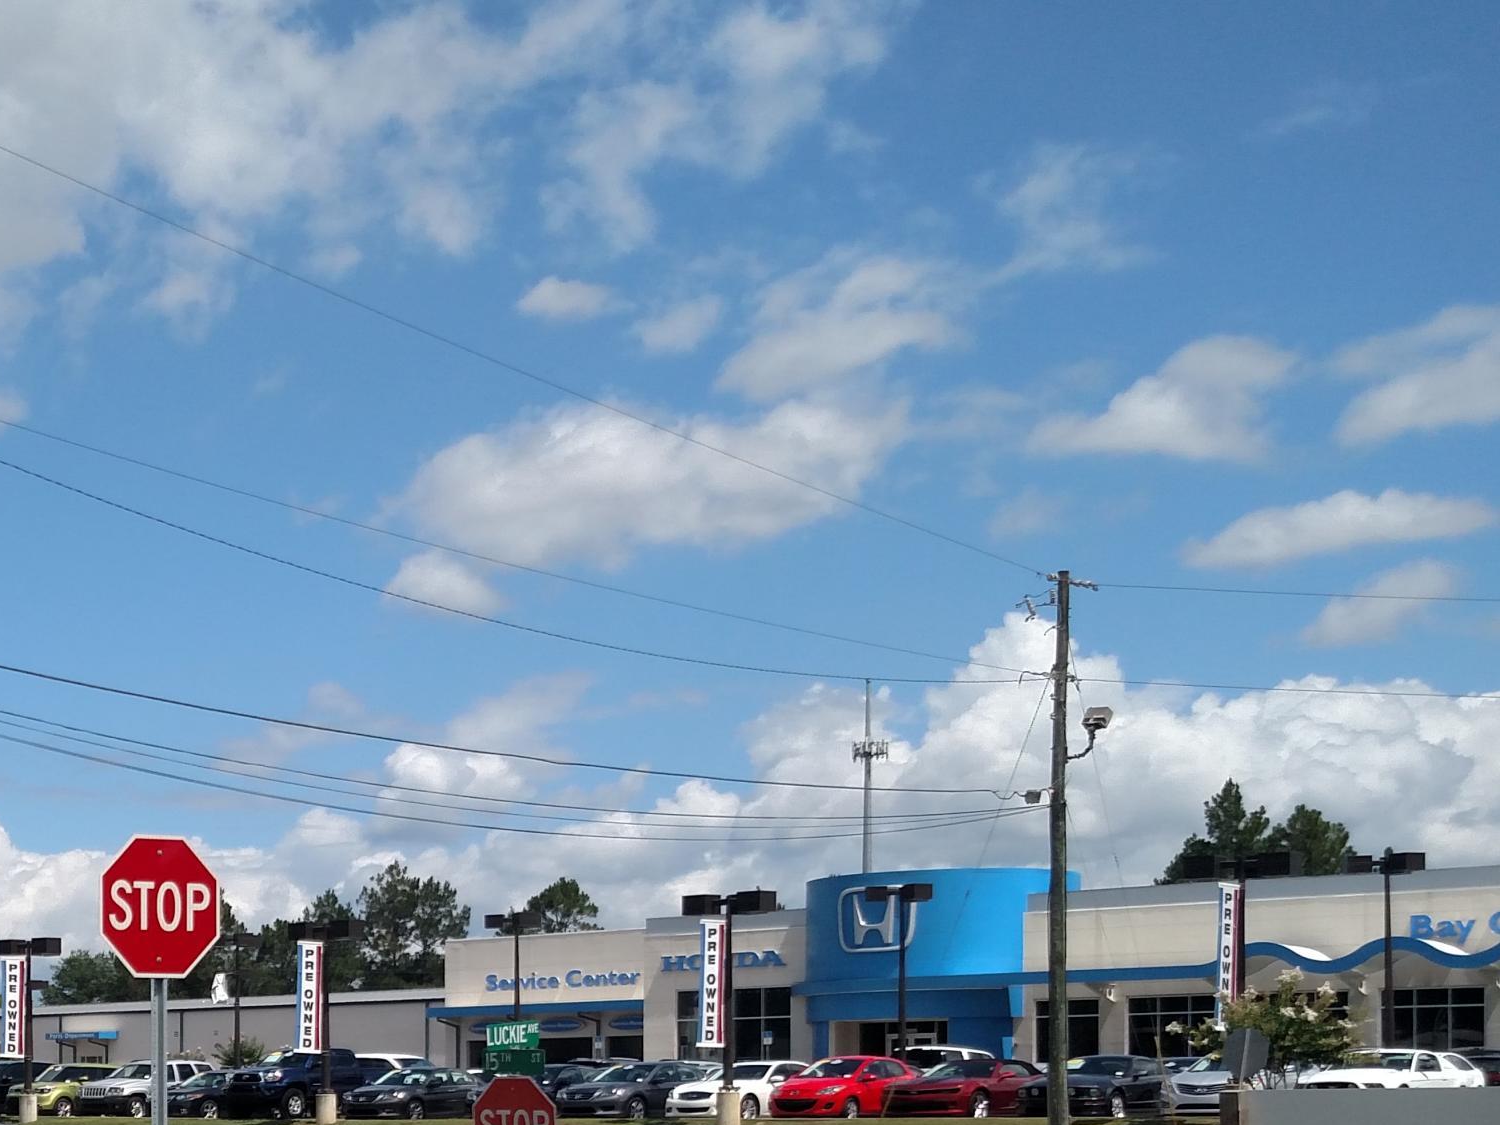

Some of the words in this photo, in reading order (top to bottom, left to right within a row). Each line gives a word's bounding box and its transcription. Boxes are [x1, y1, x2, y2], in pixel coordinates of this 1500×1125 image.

[108, 879, 211, 932] STOP
[1223, 892, 1233, 936] PRE
[707, 928, 718, 965] PRE
[1409, 914, 1477, 945] Bay
[8, 963, 18, 993] PRE
[304, 948, 315, 982] PRE
[661, 950, 787, 972] HODA
[484, 972, 560, 992] Service
[565, 969, 641, 989] Center
[302, 989, 314, 1049] OWNED
[704, 973, 717, 1042] OWNED
[7, 999, 18, 1053] OWNED
[485, 1023, 528, 1047] LUCKIE
[527, 1022, 540, 1034] AVE
